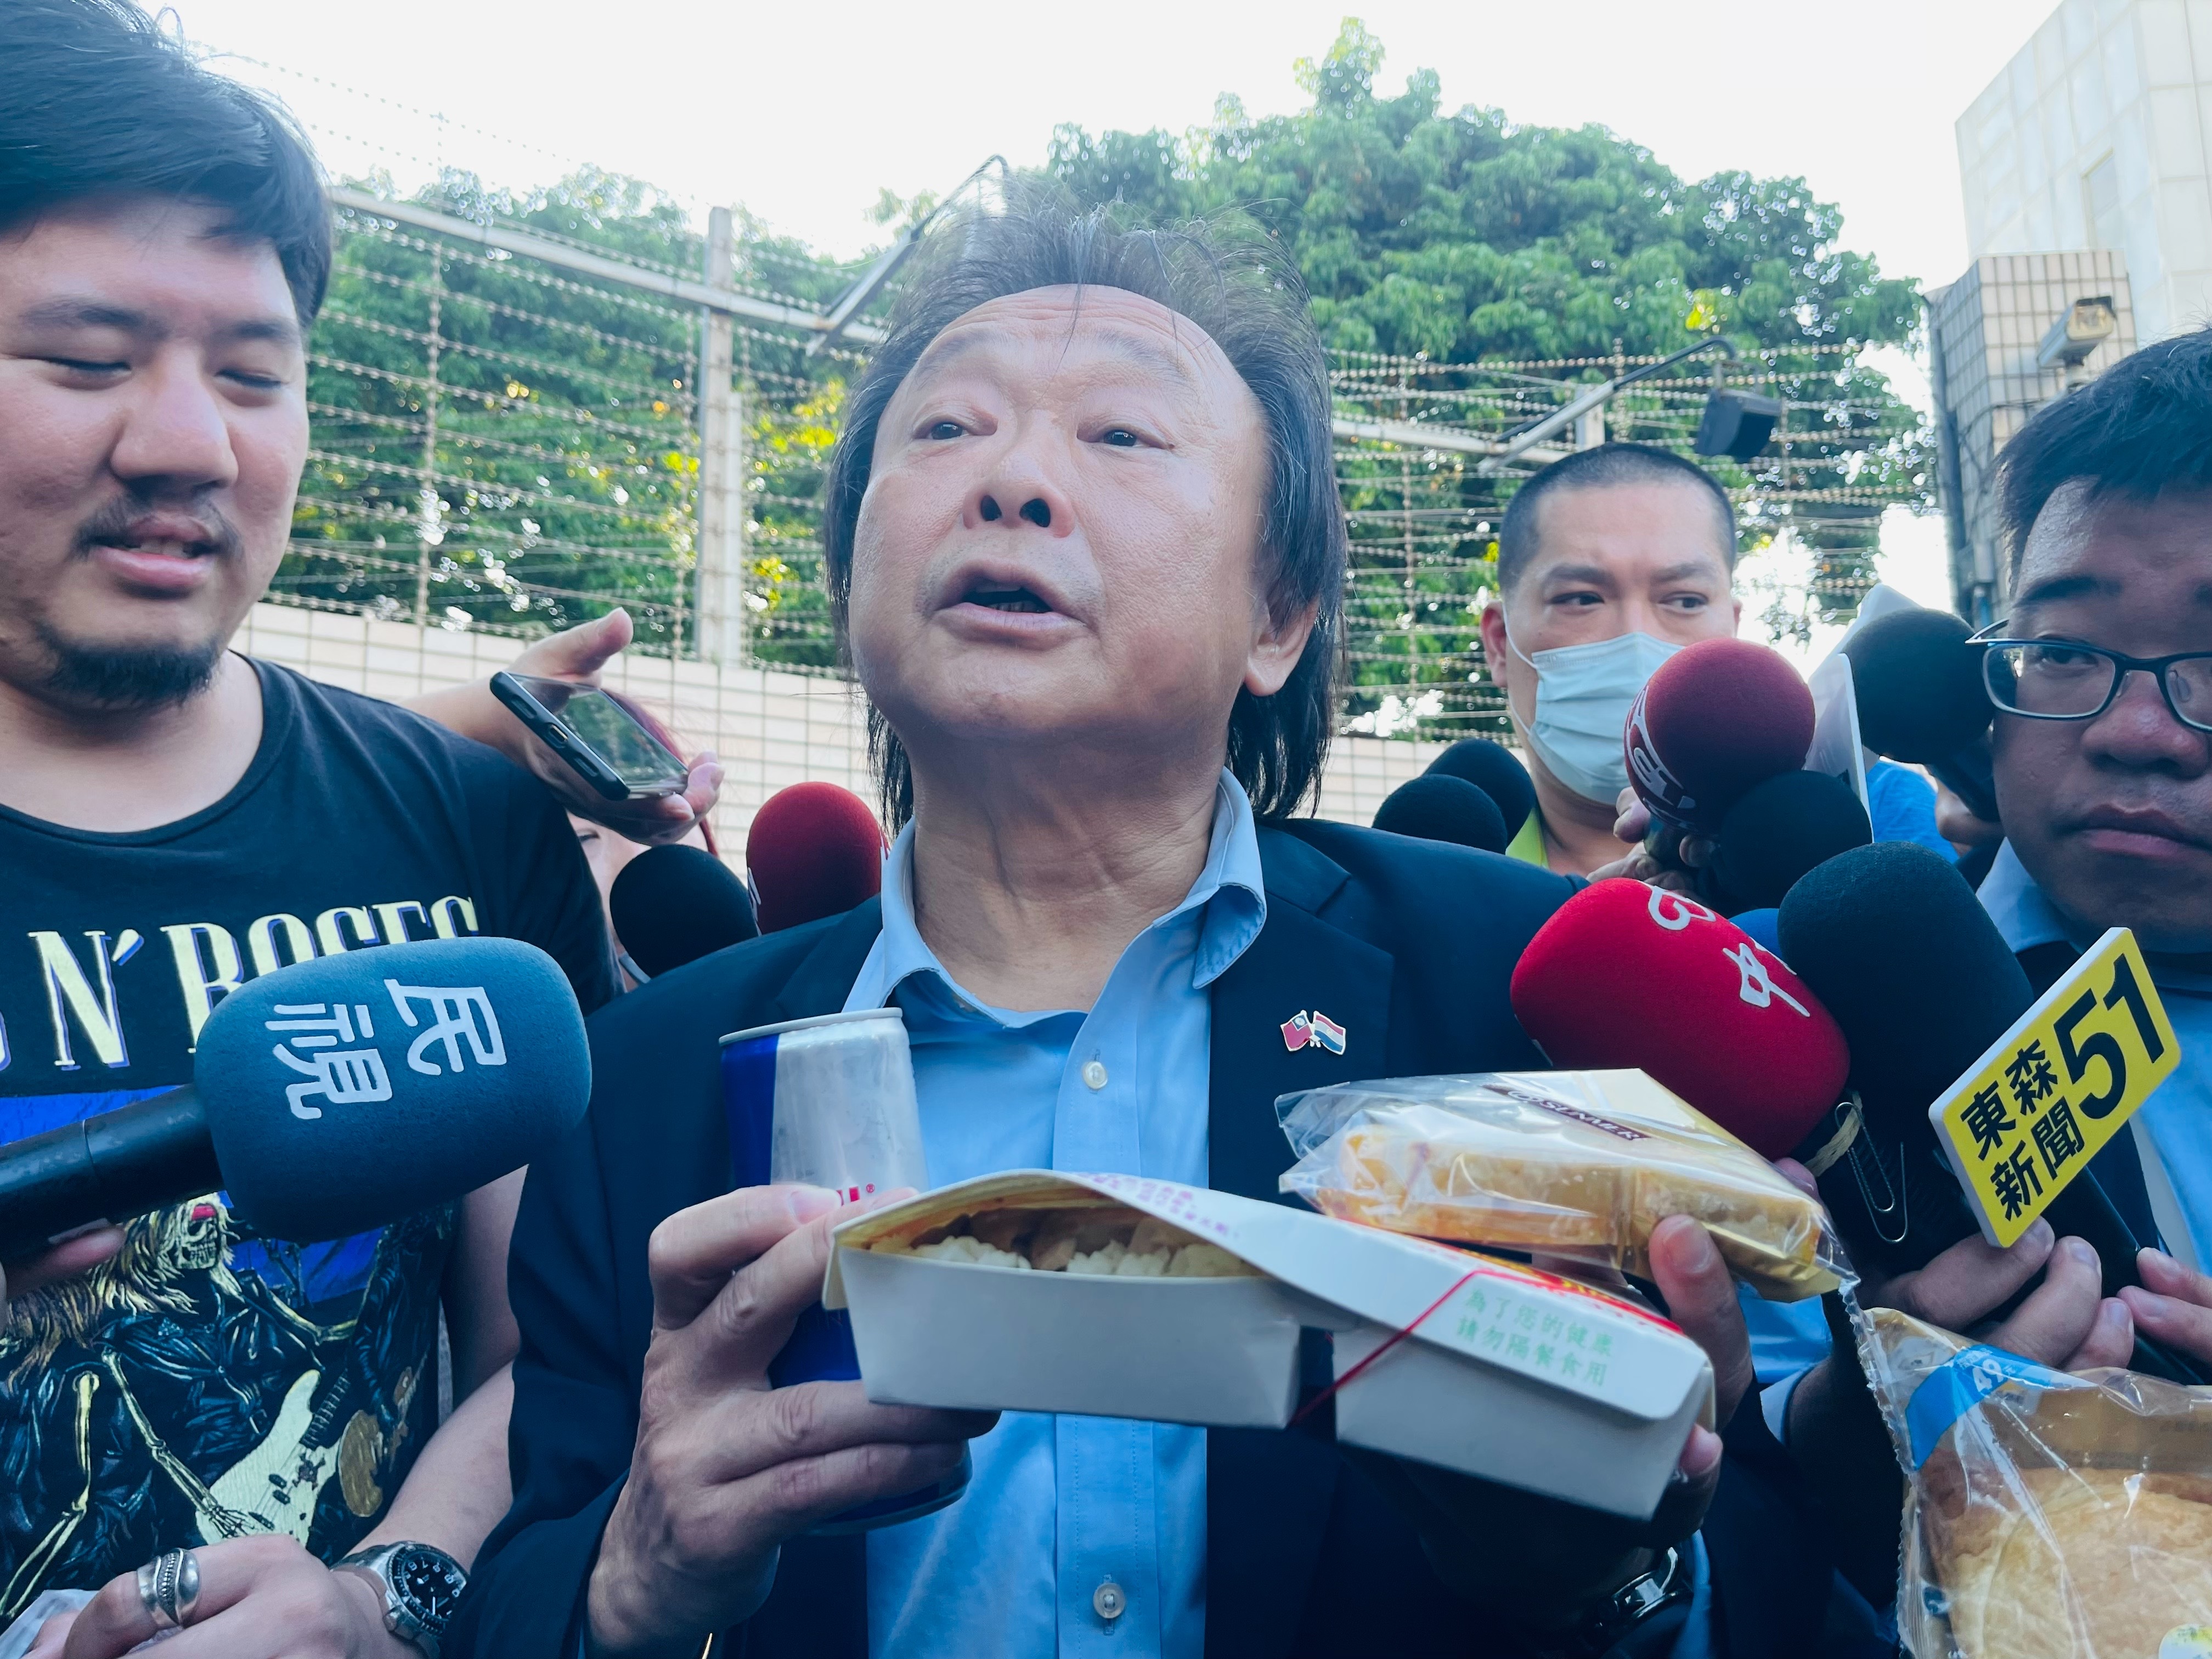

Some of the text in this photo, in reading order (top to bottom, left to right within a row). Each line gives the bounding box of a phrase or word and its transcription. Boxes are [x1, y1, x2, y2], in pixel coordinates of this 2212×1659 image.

[264, 979, 507, 1120] 民視
[1960, 1039, 2058, 1161] 東森
[2053, 953, 2164, 1120] 51
[1990, 1095, 2085, 1222] 新聞
